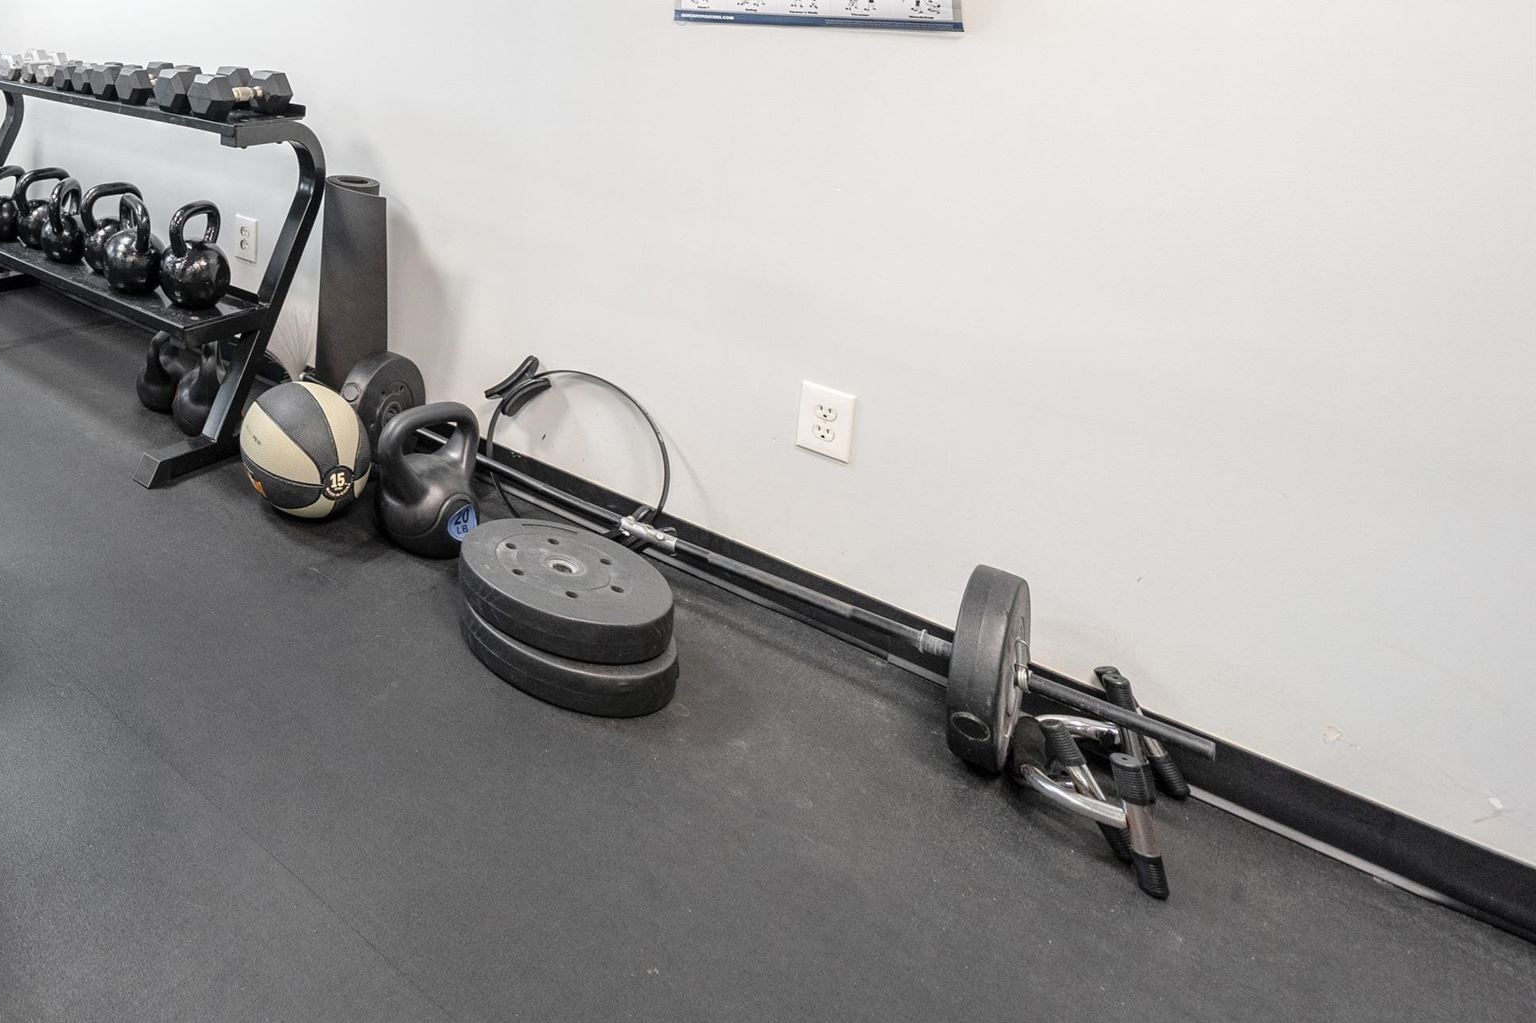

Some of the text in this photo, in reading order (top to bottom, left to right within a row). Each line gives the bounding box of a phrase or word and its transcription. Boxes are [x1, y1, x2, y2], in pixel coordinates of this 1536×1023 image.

[330, 472, 345, 488] 15
[454, 508, 470, 525] 20
[456, 525, 469, 535] LB
